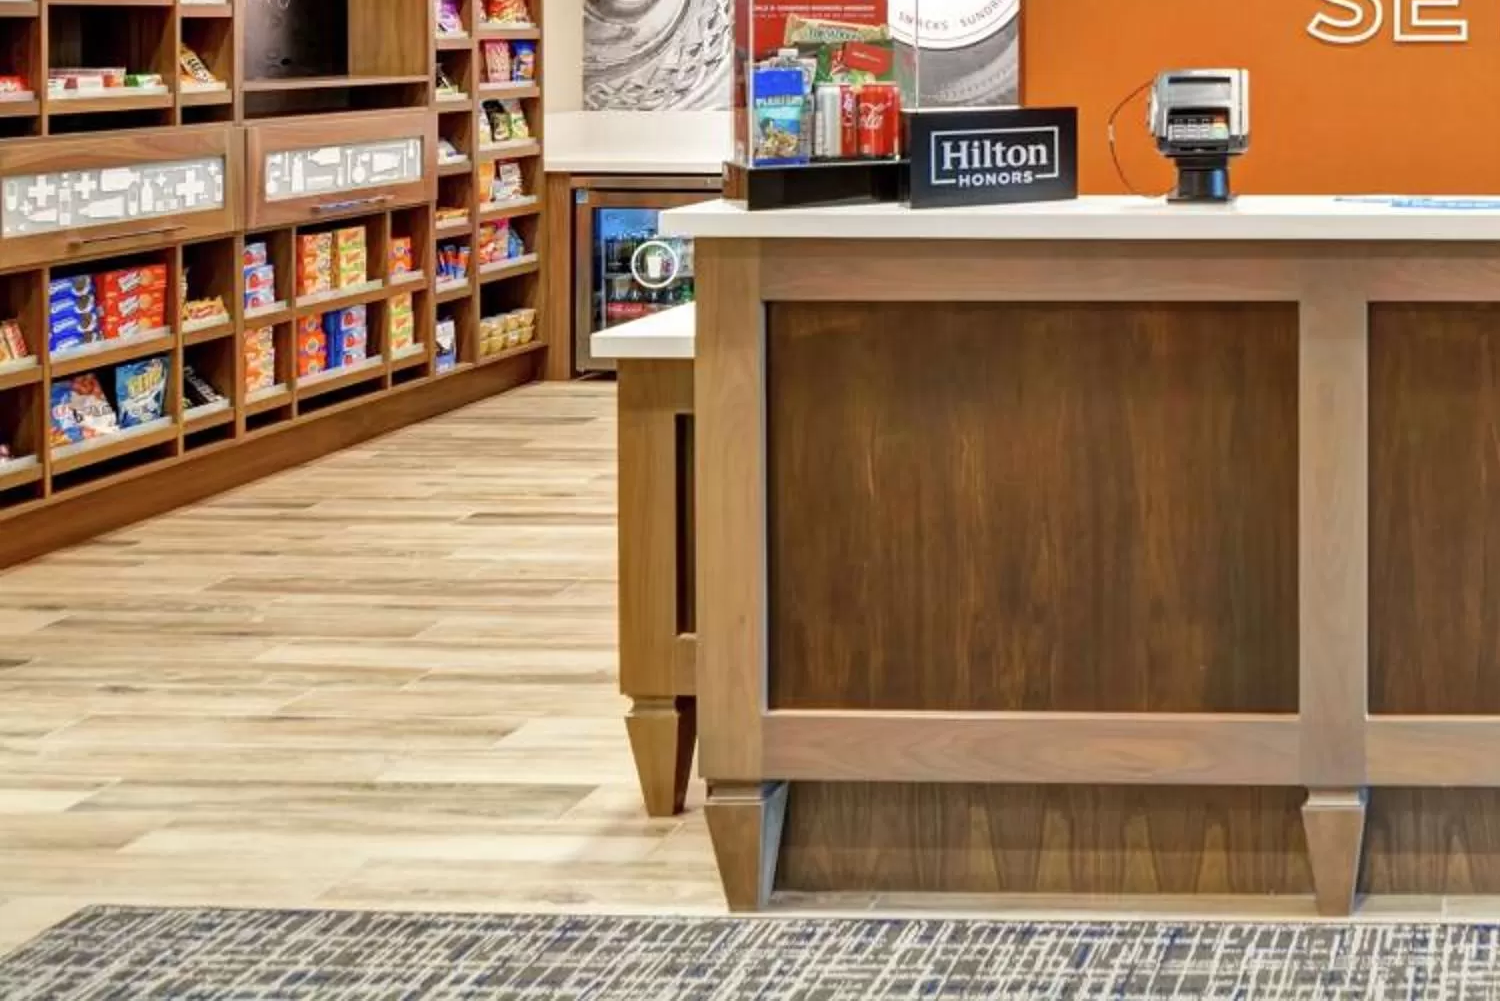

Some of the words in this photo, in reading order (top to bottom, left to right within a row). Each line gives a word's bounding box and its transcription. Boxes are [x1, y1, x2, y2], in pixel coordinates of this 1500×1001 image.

[898, 11, 949, 31] SNACKS
[941, 138, 1049, 171] Hilton
[957, 170, 1033, 188] HONORS
